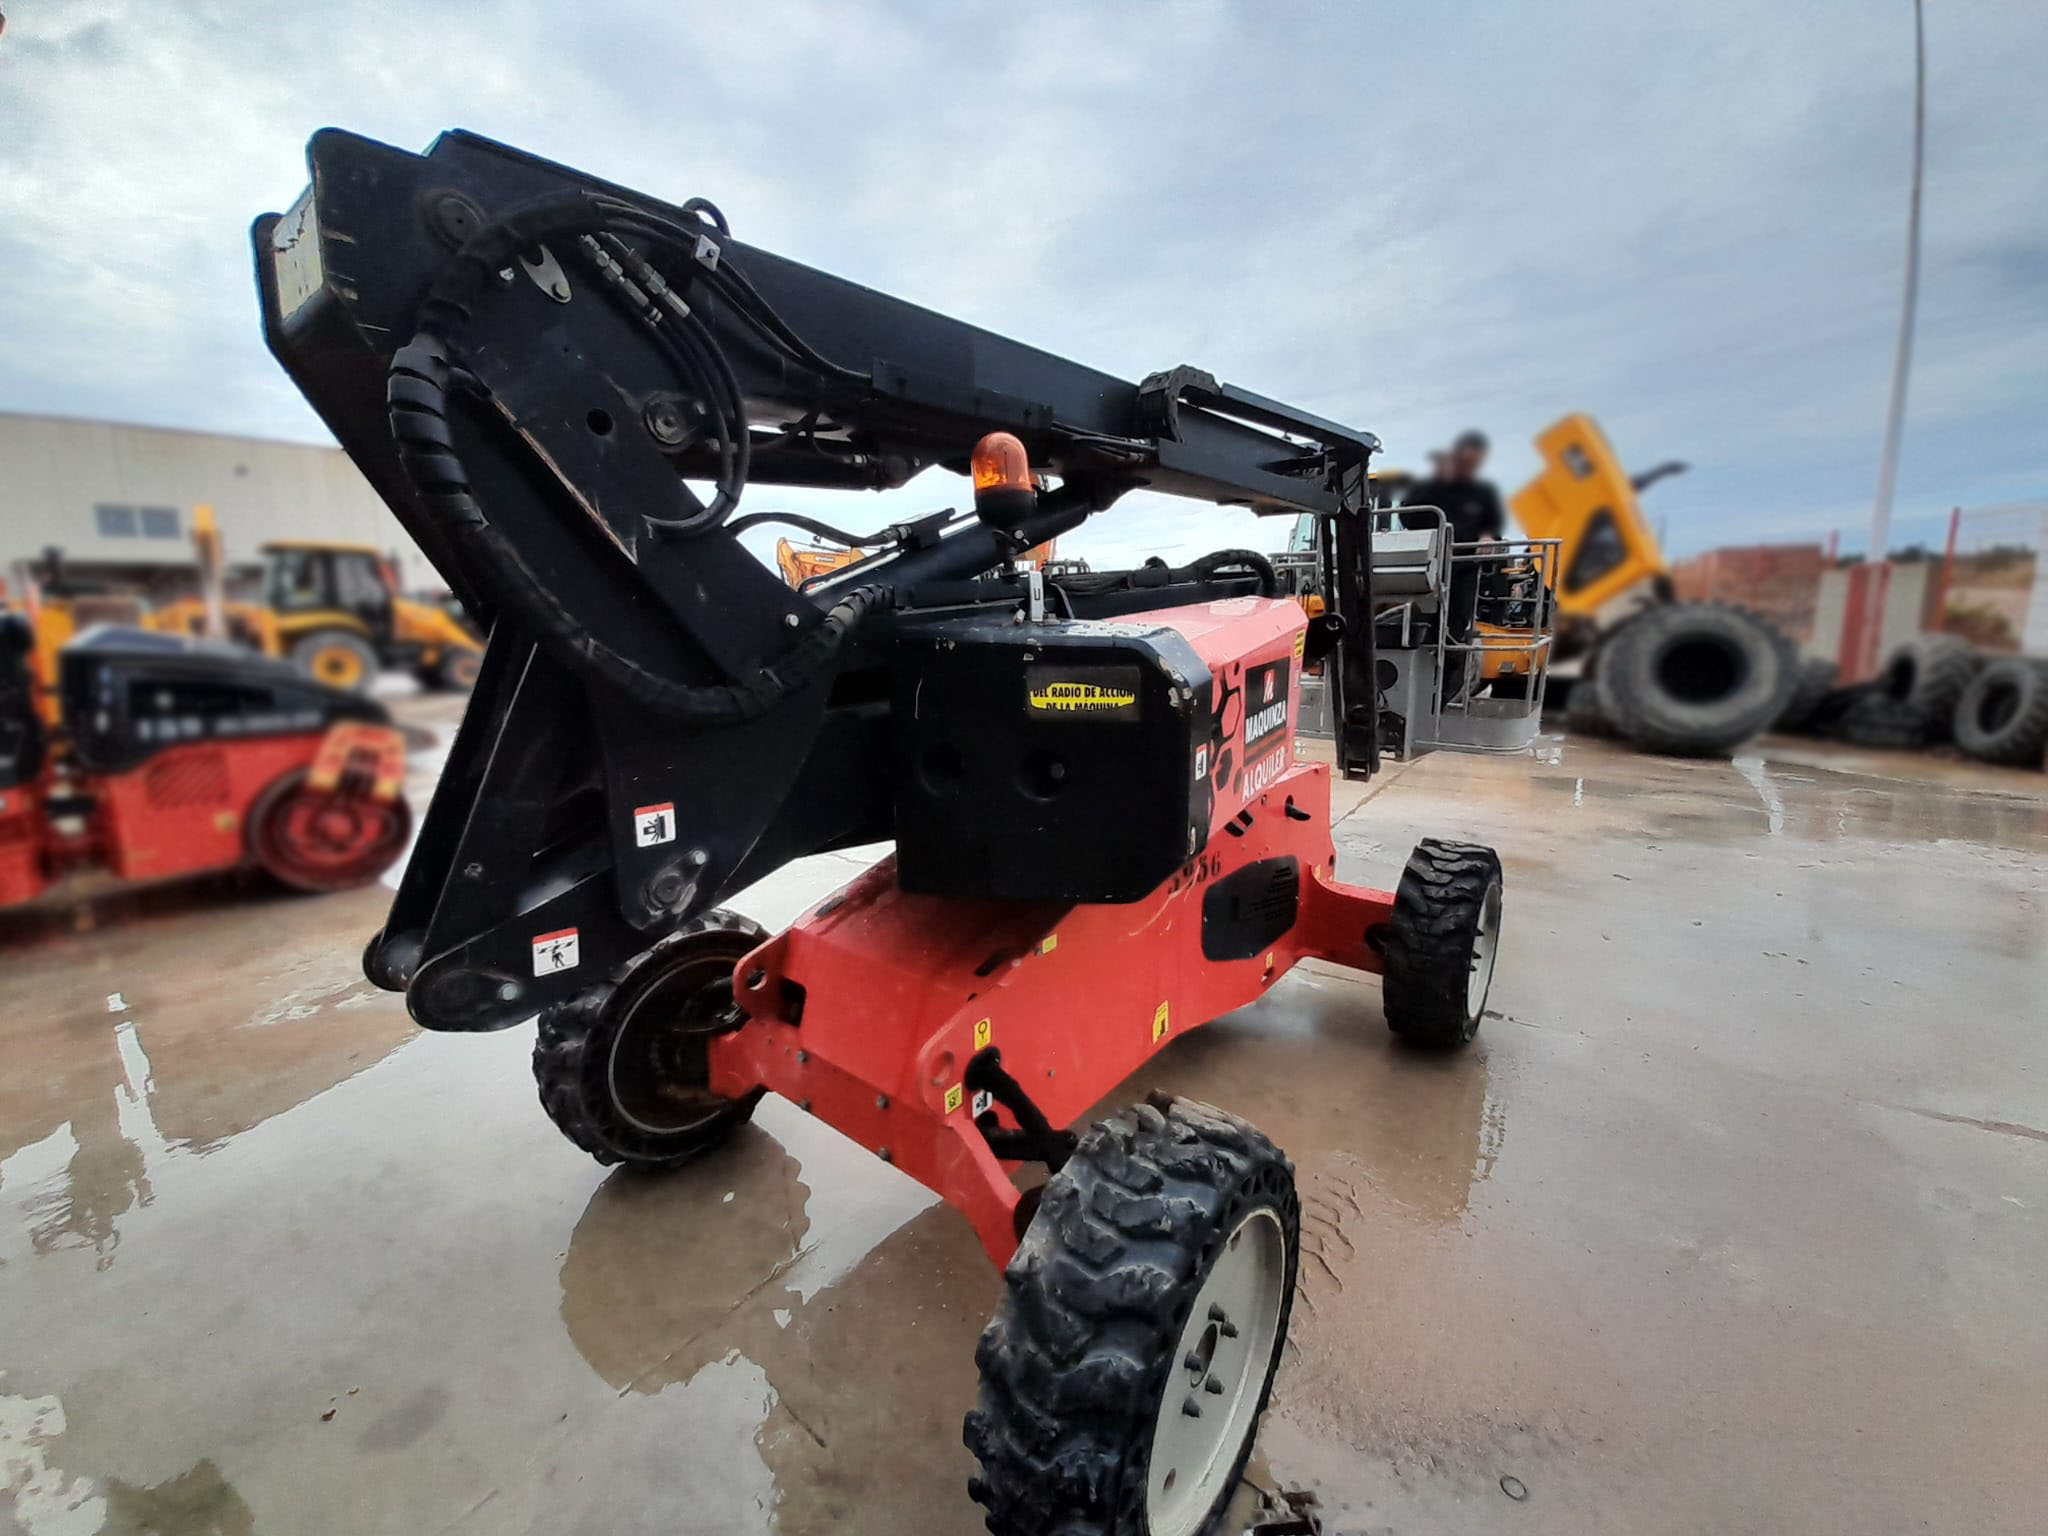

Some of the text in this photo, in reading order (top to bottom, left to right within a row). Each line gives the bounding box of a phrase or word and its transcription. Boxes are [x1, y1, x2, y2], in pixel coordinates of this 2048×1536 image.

[1051, 687, 1081, 698] RADIO
[1084, 687, 1097, 698] DE
[1245, 700, 1287, 745] MAQUINZA
[1241, 746, 1285, 803] ALQUILER
